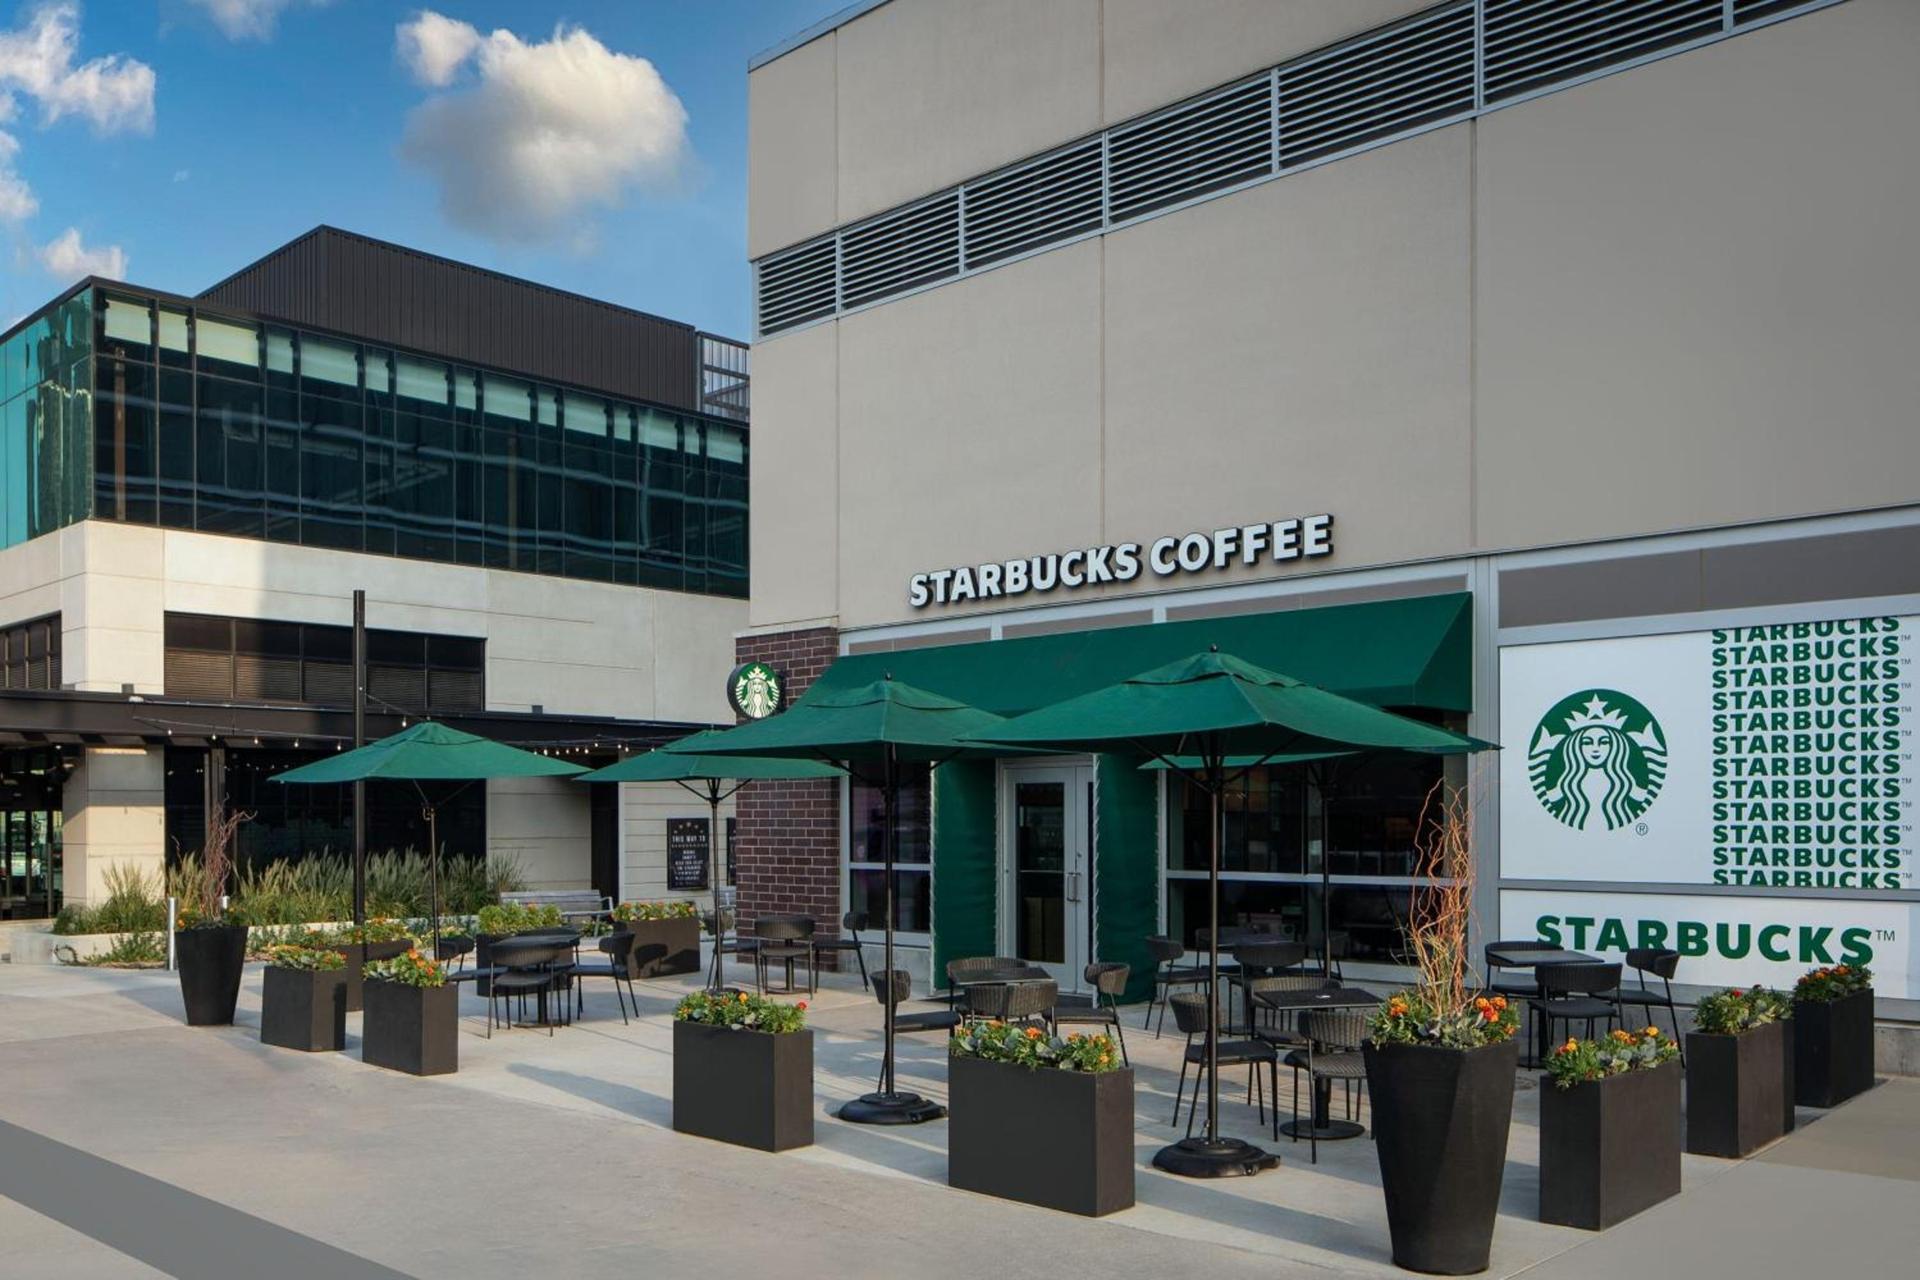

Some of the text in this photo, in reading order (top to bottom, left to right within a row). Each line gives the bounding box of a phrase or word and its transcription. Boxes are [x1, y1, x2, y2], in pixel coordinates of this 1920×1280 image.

[909, 514, 1332, 608] STARBUCKS COFFEE
[1712, 636, 1900, 667] STARBUCKS
[1712, 659, 1900, 689] STARBUCKS
[1712, 683, 1900, 711] STARBUCKS
[1712, 707, 1900, 733] STARBUCKS
[1712, 731, 1900, 755] STARBUCKS
[1712, 754, 1900, 778] STARBUCKS
[1712, 777, 1900, 800] STARBUCKS
[1712, 801, 1900, 822] STARBUCKS
[1712, 825, 1900, 846] STARBUCKS
[1712, 847, 1900, 869] STARBUCKS
[1536, 915, 1874, 968] STARBUCKS
